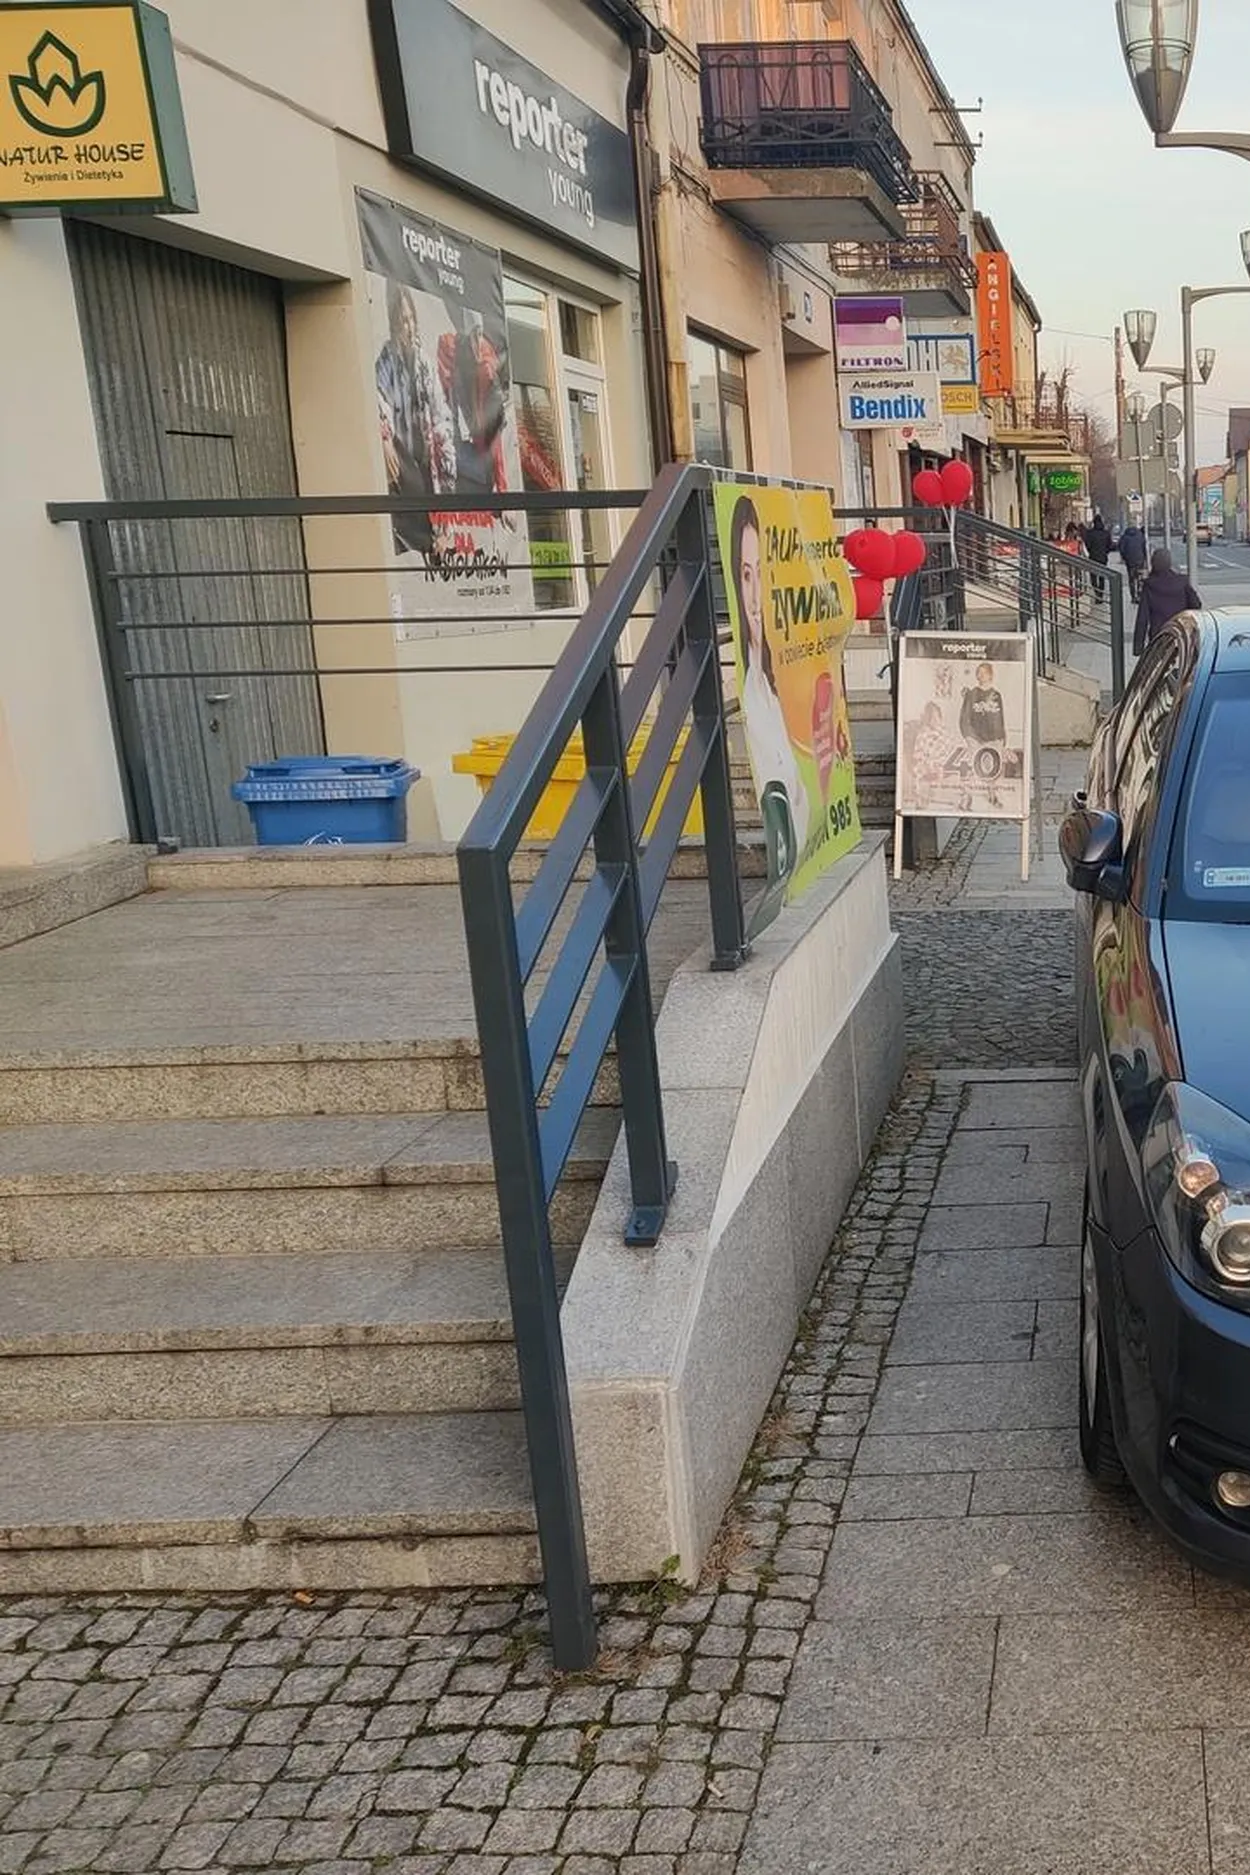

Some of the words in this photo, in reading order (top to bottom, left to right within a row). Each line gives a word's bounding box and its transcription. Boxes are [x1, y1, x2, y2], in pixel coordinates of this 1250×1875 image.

[474, 59, 588, 176] reporter
[74, 143, 146, 164] HOUSE
[548, 168, 596, 229] young
[402, 225, 462, 270] reporter
[849, 394, 927, 420] Bendix
[942, 392, 973, 404] OSCH
[942, 643, 987, 654] reporter
[829, 795, 852, 837] 985
